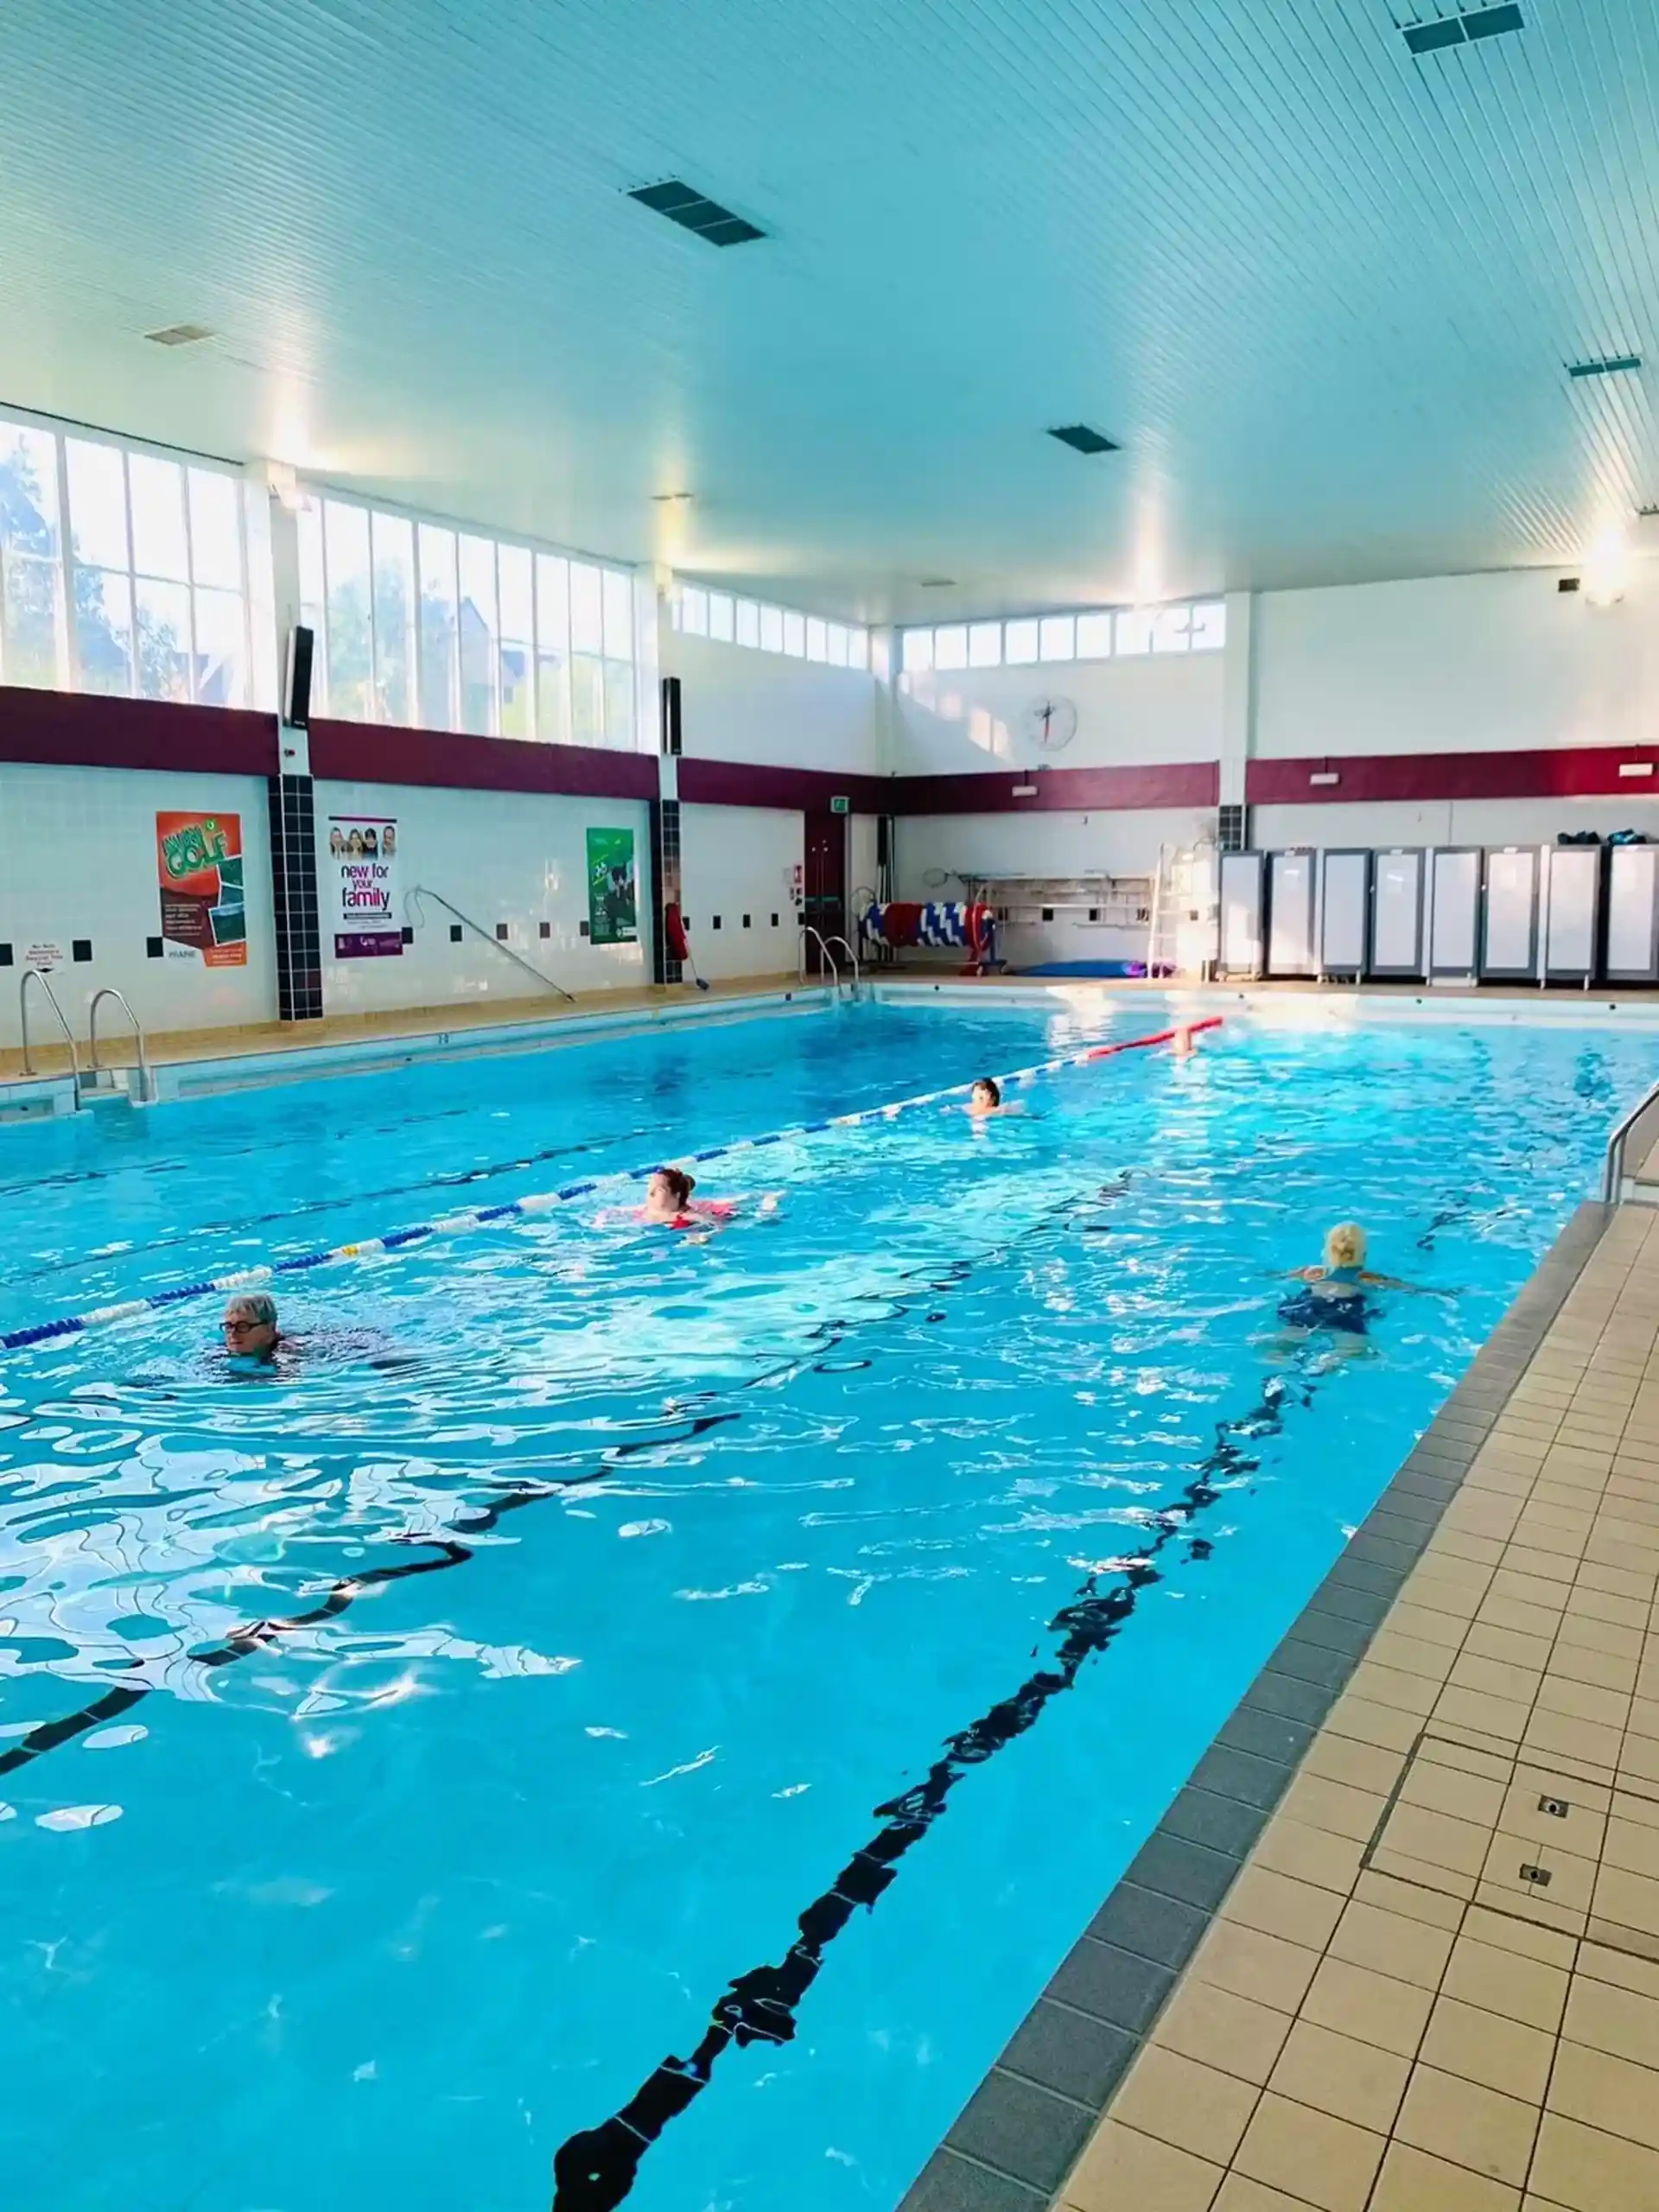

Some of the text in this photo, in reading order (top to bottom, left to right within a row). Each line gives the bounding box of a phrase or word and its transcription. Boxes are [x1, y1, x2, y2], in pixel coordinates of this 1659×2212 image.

[164, 830, 228, 880] GOLF
[341, 862, 389, 879] new for
[352, 880, 373, 892] your
[342, 887, 391, 911] family
